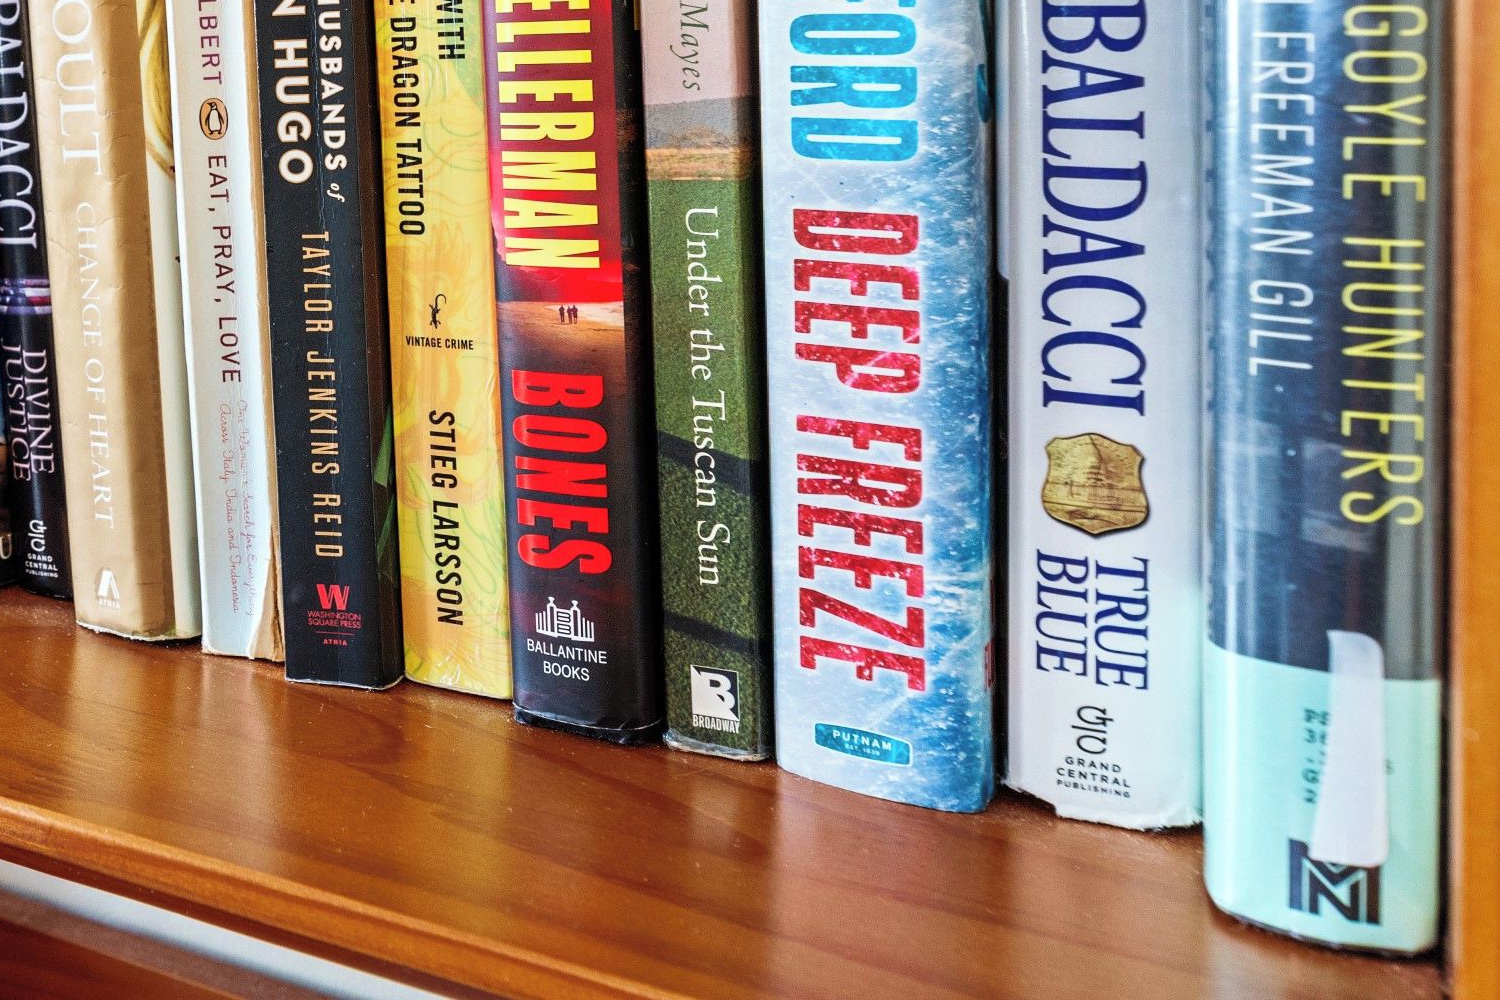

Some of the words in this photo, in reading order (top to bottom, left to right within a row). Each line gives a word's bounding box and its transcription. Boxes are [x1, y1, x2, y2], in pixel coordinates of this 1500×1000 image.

[390, 16, 420, 128] DRAGON
[670, 1, 709, 91] Mayes
[273, 38, 314, 185] HUGO
[1250, 31, 1317, 256] FREEMAN
[207, 154, 228, 212] EAT,
[325, 180, 345, 204] of
[397, 137, 425, 237] TATTOO
[73, 200, 103, 350] CHANGE
[212, 225, 235, 303] PRAY,
[300, 231, 334, 334] TAYLOR
[685, 204, 724, 314] Under
[793, 207, 921, 394] DEEP
[1248, 279, 1314, 376] GILL
[218, 316, 242, 383] LOVE
[405, 335, 442, 349] VINTAGE
[444, 337, 474, 350] CRIME
[689, 329, 725, 380] the
[1, 338, 32, 483] JUSTICE
[22, 347, 55, 475] DIVINE
[85, 357, 107, 403] OF
[306, 350, 340, 476] JENKINS
[1340, 236, 1426, 527] HUNTERS
[219, 403, 231, 444] Across
[428, 410, 458, 490] STIEG
[691, 388, 726, 508] Tuscan
[87, 412, 114, 531] HEART
[510, 369, 613, 575] BONES
[27, 552, 53, 563] GRAND
[227, 528, 239, 551] and
[312, 493, 343, 558] REID
[697, 521, 731, 586] Sun
[796, 414, 926, 693] FREEZE
[25, 561, 58, 571] CENTRAL
[25, 569, 59, 579] PUBLISHING
[229, 554, 242, 614] Indonesia
[432, 501, 464, 628] LARSSON
[307, 610, 362, 621] WASHINGTON
[308, 618, 338, 627] SQUARE
[340, 620, 362, 629] PRESS
[323, 638, 348, 646] ATRIA
[1035, 548, 1089, 678] BLUE
[1094, 556, 1150, 691] TRUE
[526, 636, 608, 665] BALLANTINE
[543, 660, 590, 682] BOOKS
[692, 714, 740, 735] BROADWAY
[832, 729, 893, 751] PUTNAM
[1056, 767, 1132, 788] CENTRAL
[1056, 779, 1132, 798] PUBLISHING
[1065, 756, 1122, 773] GRAND
